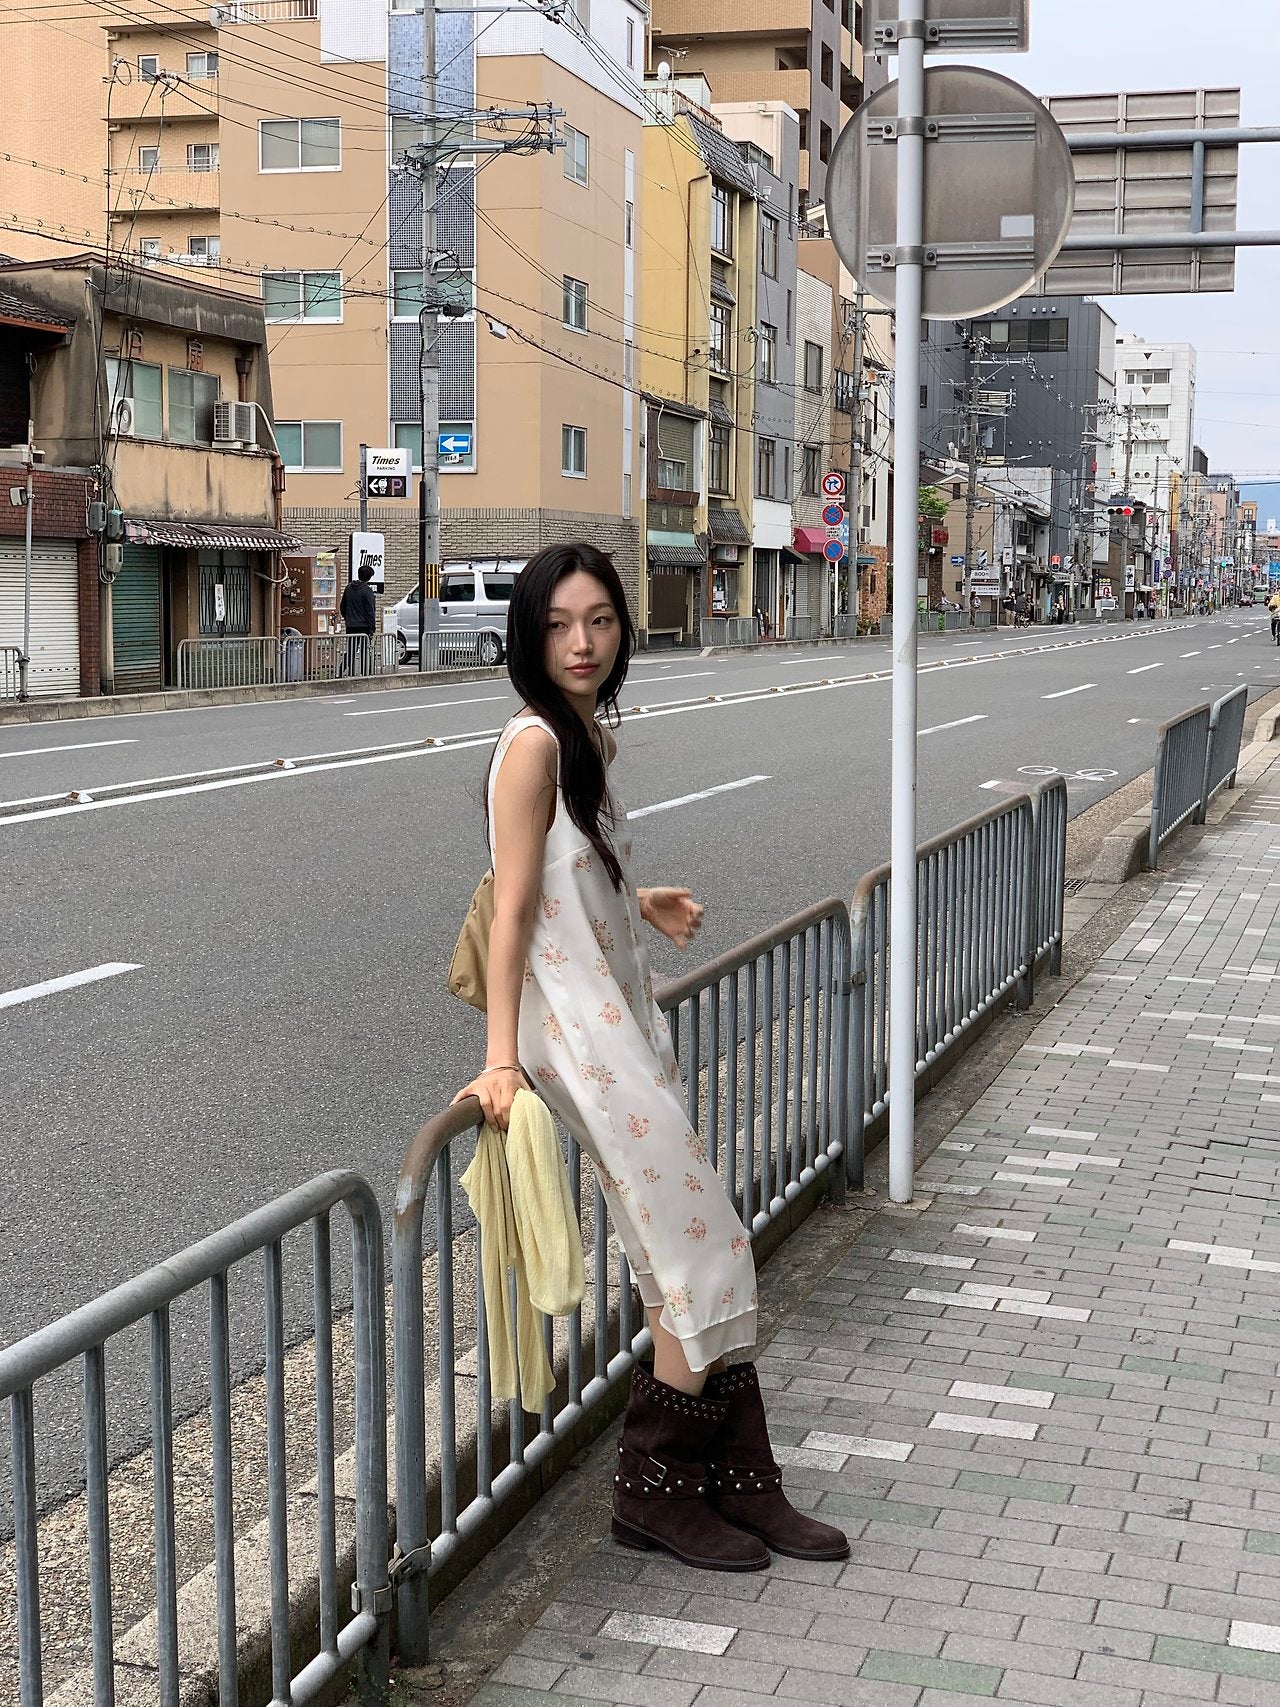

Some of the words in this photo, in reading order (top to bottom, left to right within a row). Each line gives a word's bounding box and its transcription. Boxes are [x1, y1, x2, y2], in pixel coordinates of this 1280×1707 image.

[372, 455, 400, 465] Times
[391, 478, 402, 496] P
[359, 549, 382, 567] Times
